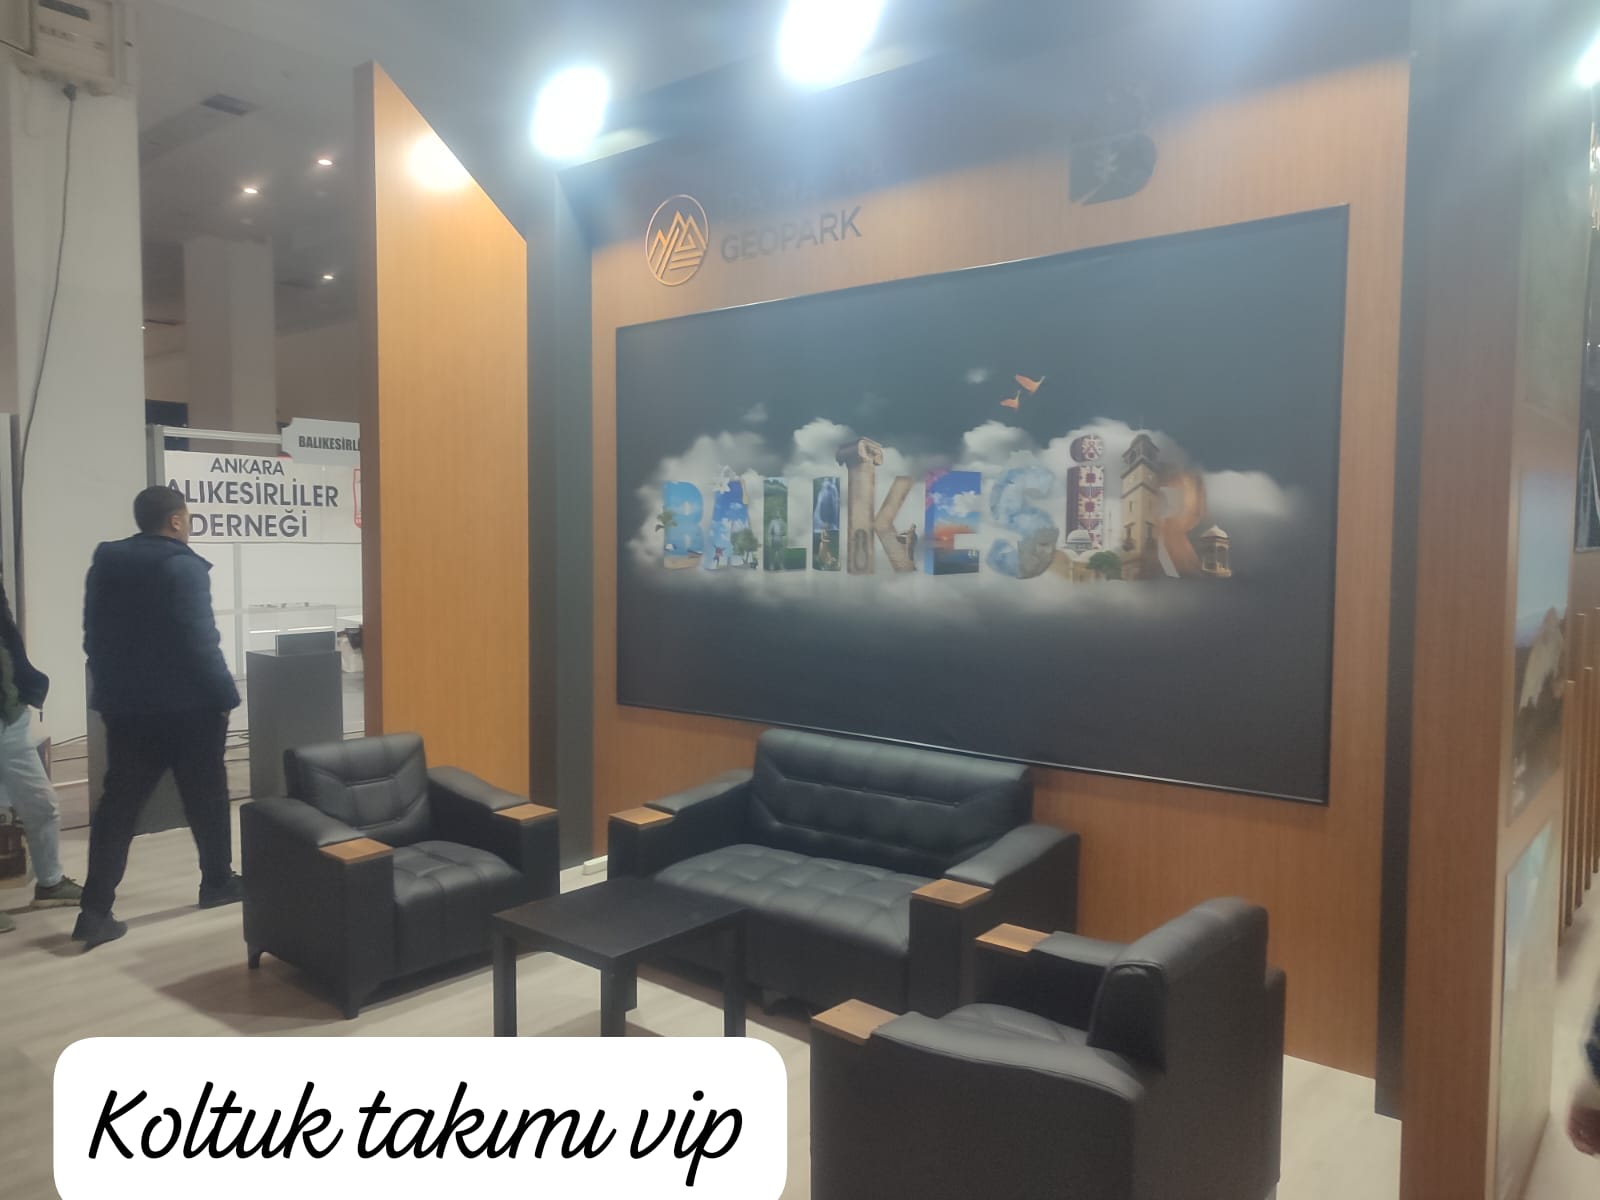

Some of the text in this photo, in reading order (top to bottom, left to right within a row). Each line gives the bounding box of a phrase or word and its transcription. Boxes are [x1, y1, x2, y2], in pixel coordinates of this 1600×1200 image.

[720, 205, 862, 263] GEOPARK
[210, 457, 285, 476] ANKARA
[167, 476, 339, 507] ALIKESİRLİLER
[662, 433, 1207, 580] BALIKESİR
[188, 508, 308, 537] DERNEĞİ
